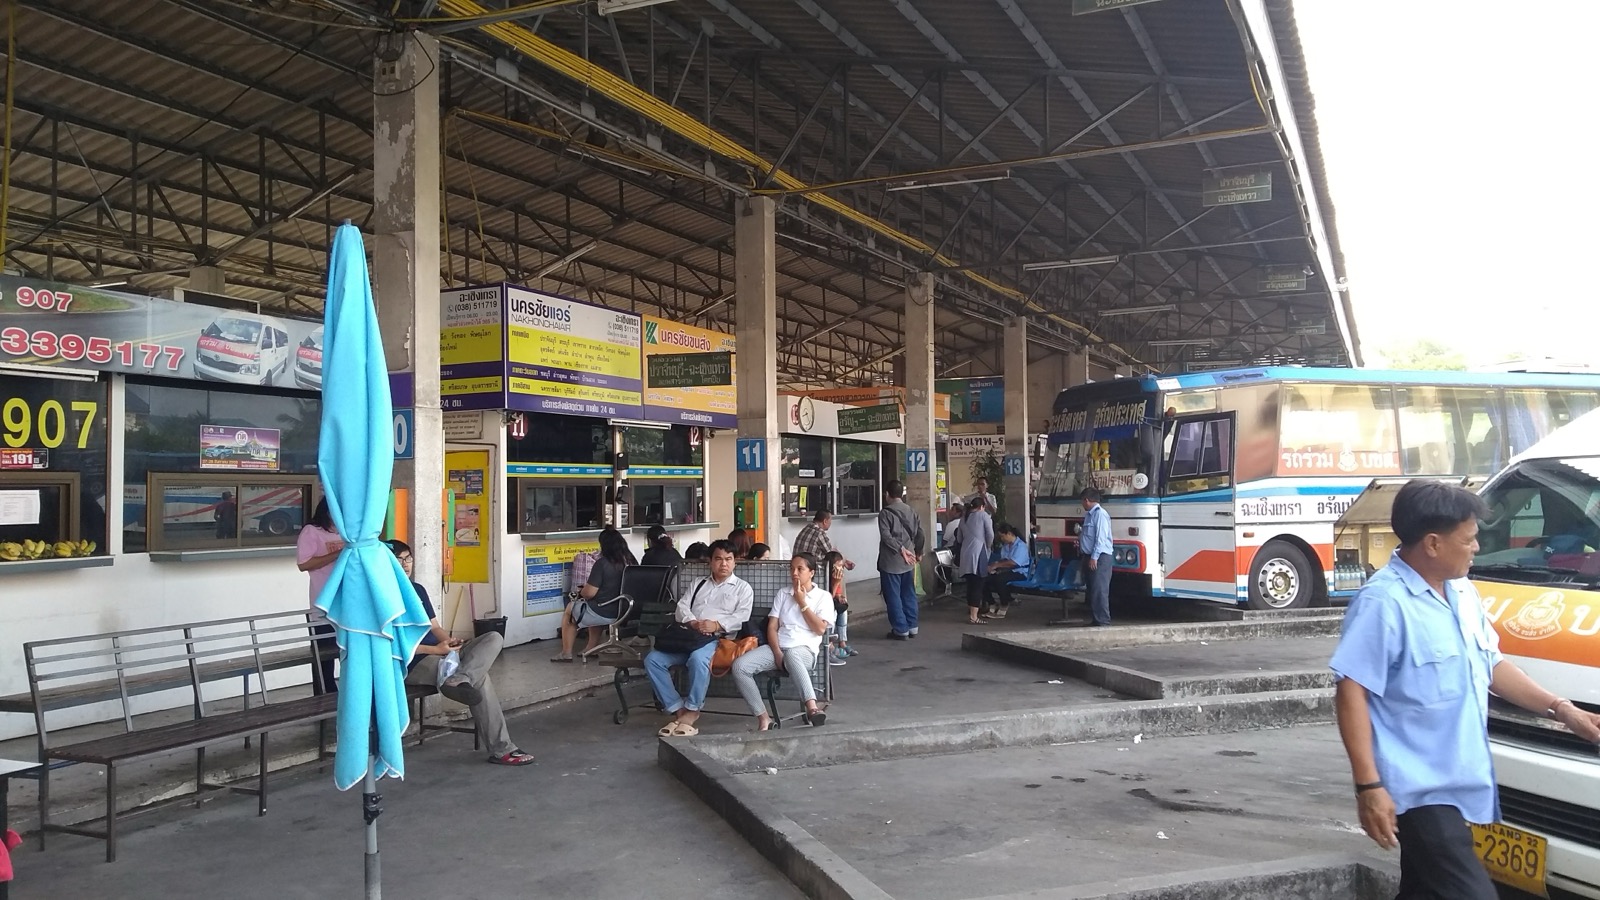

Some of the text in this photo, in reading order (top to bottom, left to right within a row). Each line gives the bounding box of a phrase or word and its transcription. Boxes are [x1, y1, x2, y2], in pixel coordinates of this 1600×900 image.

[16, 286, 73, 312] 907
[473, 301, 498, 310] 511719
[511, 298, 571, 322] นครชัยแอร์
[511, 313, 571, 332] NAKHONCHAIAIR
[660, 329, 711, 352] นครชัยขนส่ง
[600, 406, 608, 414] 24
[1093, 399, 1147, 430] อรัญประเทศ
[2, 397, 98, 449] 907
[393, 413, 408, 455] 0
[12, 453, 33, 465] 191
[742, 442, 761, 468] 11
[908, 452, 926, 472] 12
[1281, 447, 1335, 470] รถร่วม
[1007, 458, 1022, 475] 13
[1241, 497, 1303, 517] ฉะเชิงเทรา
[1526, 836, 1539, 848] 22
